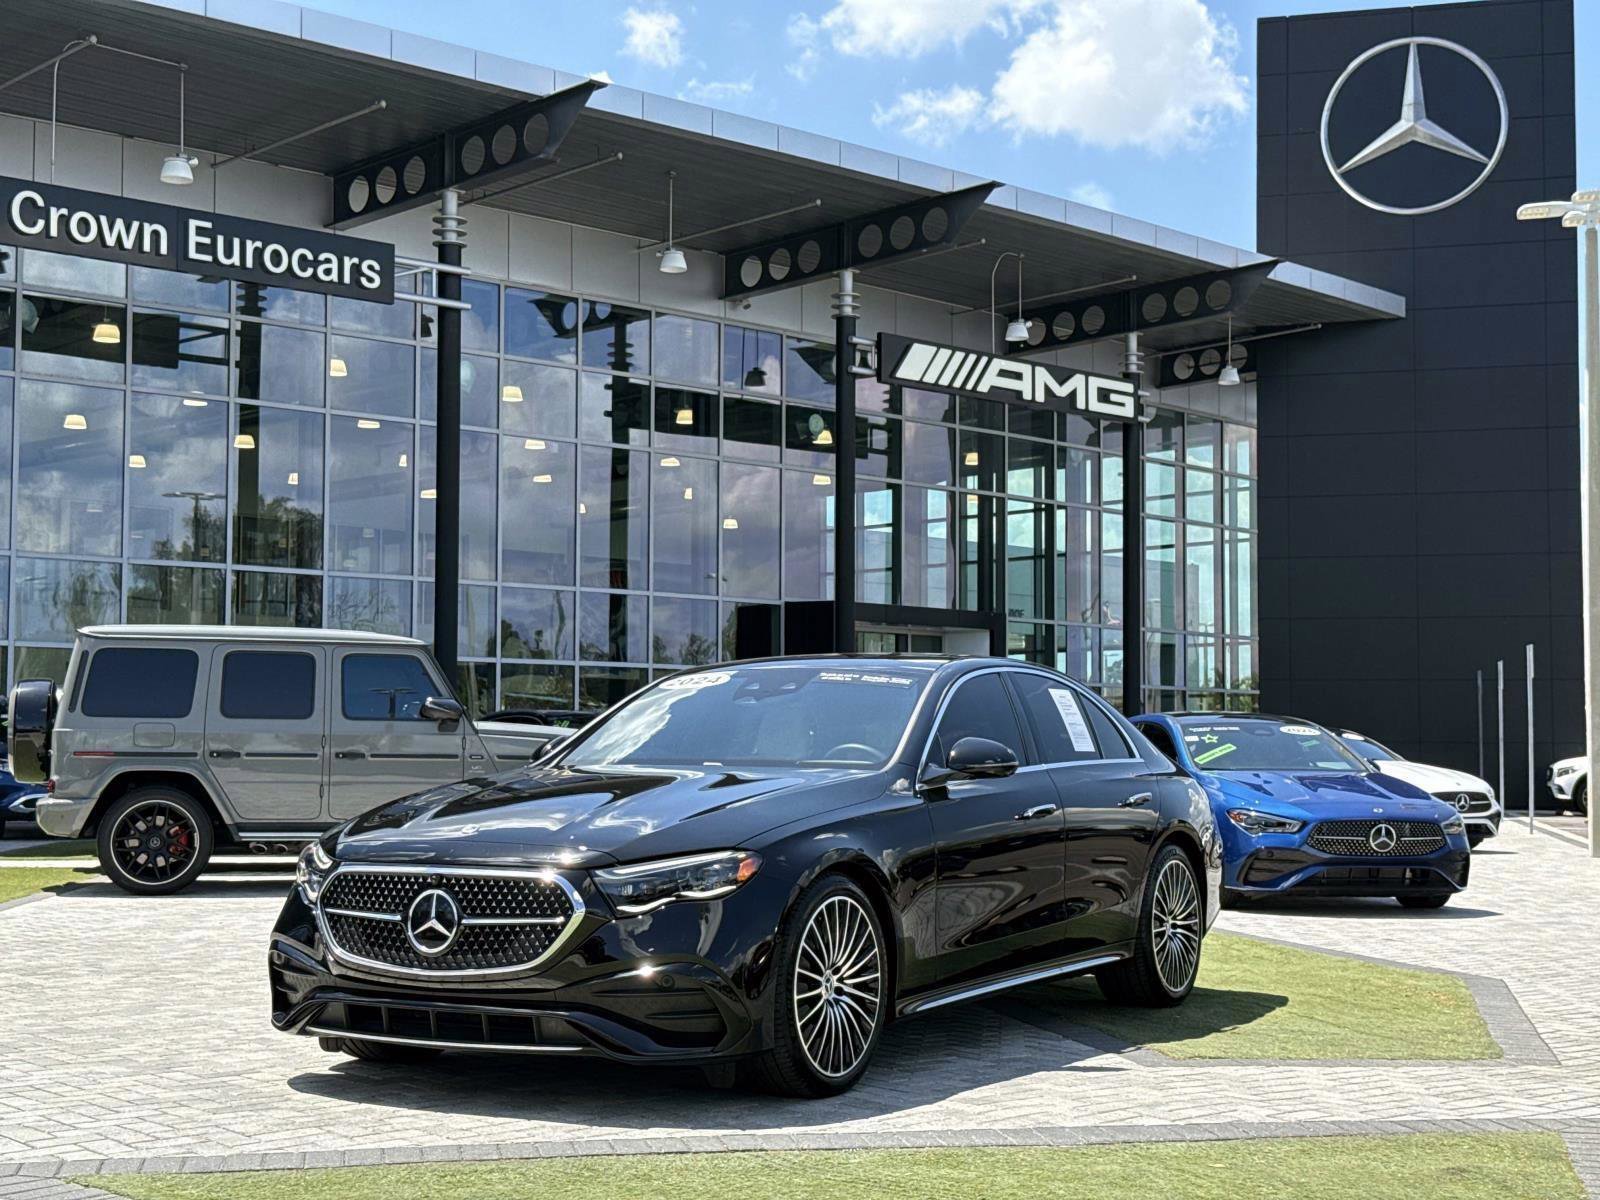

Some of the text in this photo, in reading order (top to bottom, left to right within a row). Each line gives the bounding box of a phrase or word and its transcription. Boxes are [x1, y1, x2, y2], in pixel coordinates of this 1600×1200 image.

[10, 190, 382, 290] Crown Eurocars
[976, 357, 1135, 418] AMG
